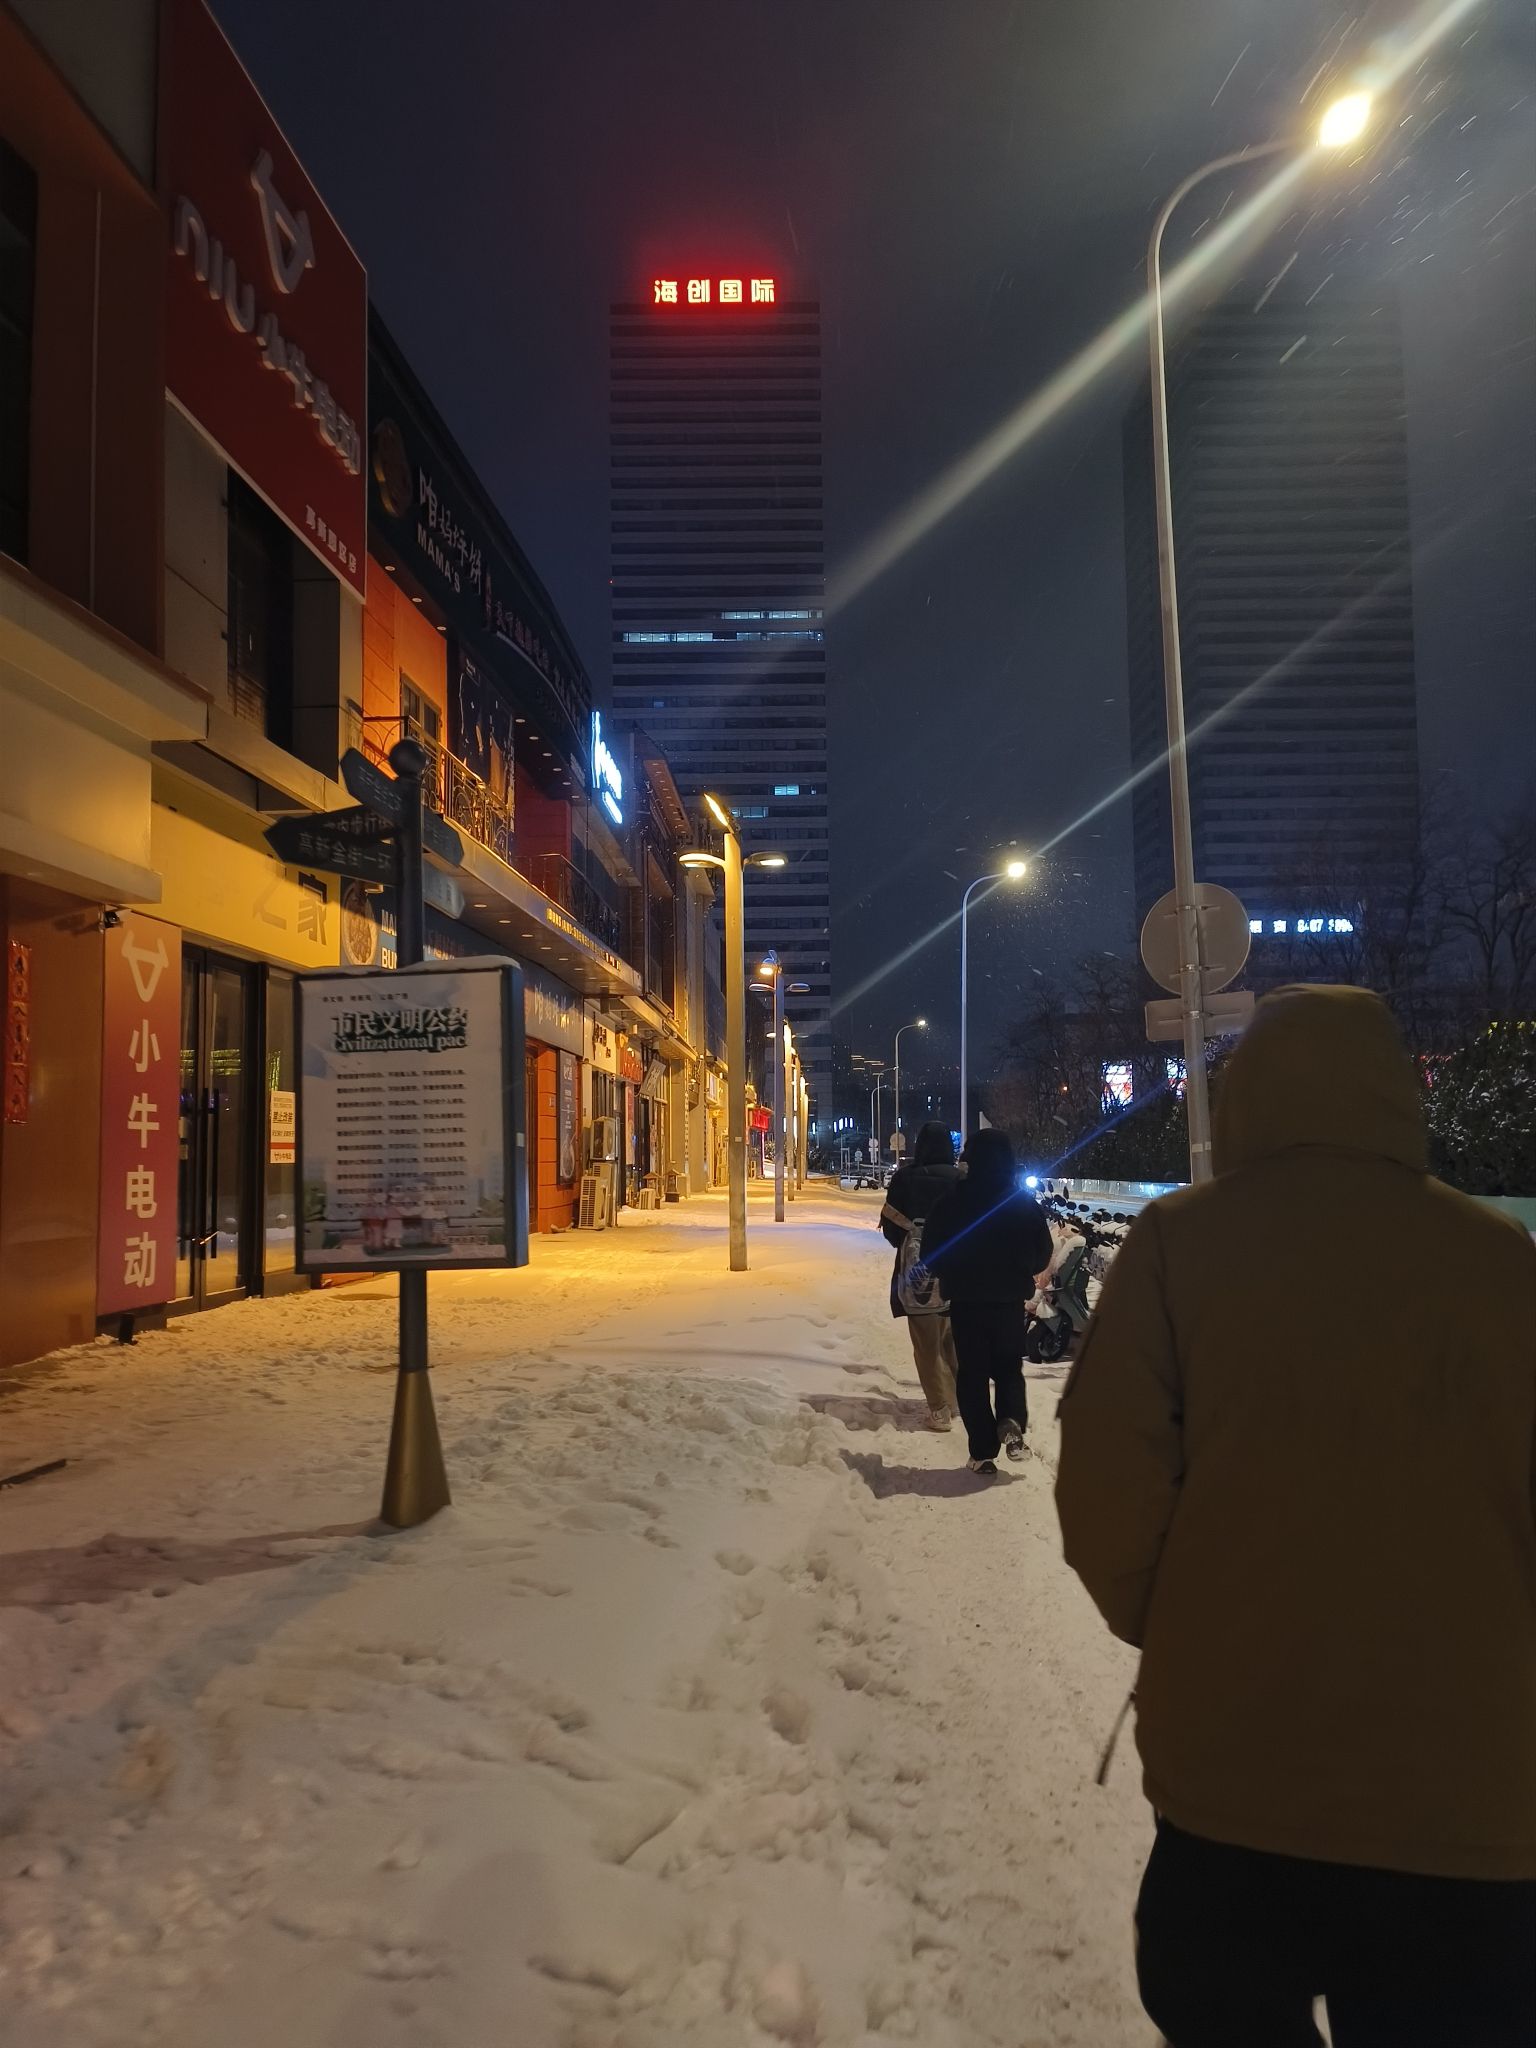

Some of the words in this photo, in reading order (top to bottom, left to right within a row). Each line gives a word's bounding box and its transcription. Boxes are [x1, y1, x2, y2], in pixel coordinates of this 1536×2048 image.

[654, 279, 775, 303] 海创国际
[417, 522, 461, 594] MAMA'S
[381, 909, 398, 936] MA
[332, 1006, 468, 1035] 市民文明公约
[123, 1019, 161, 1289] 小牛电动
